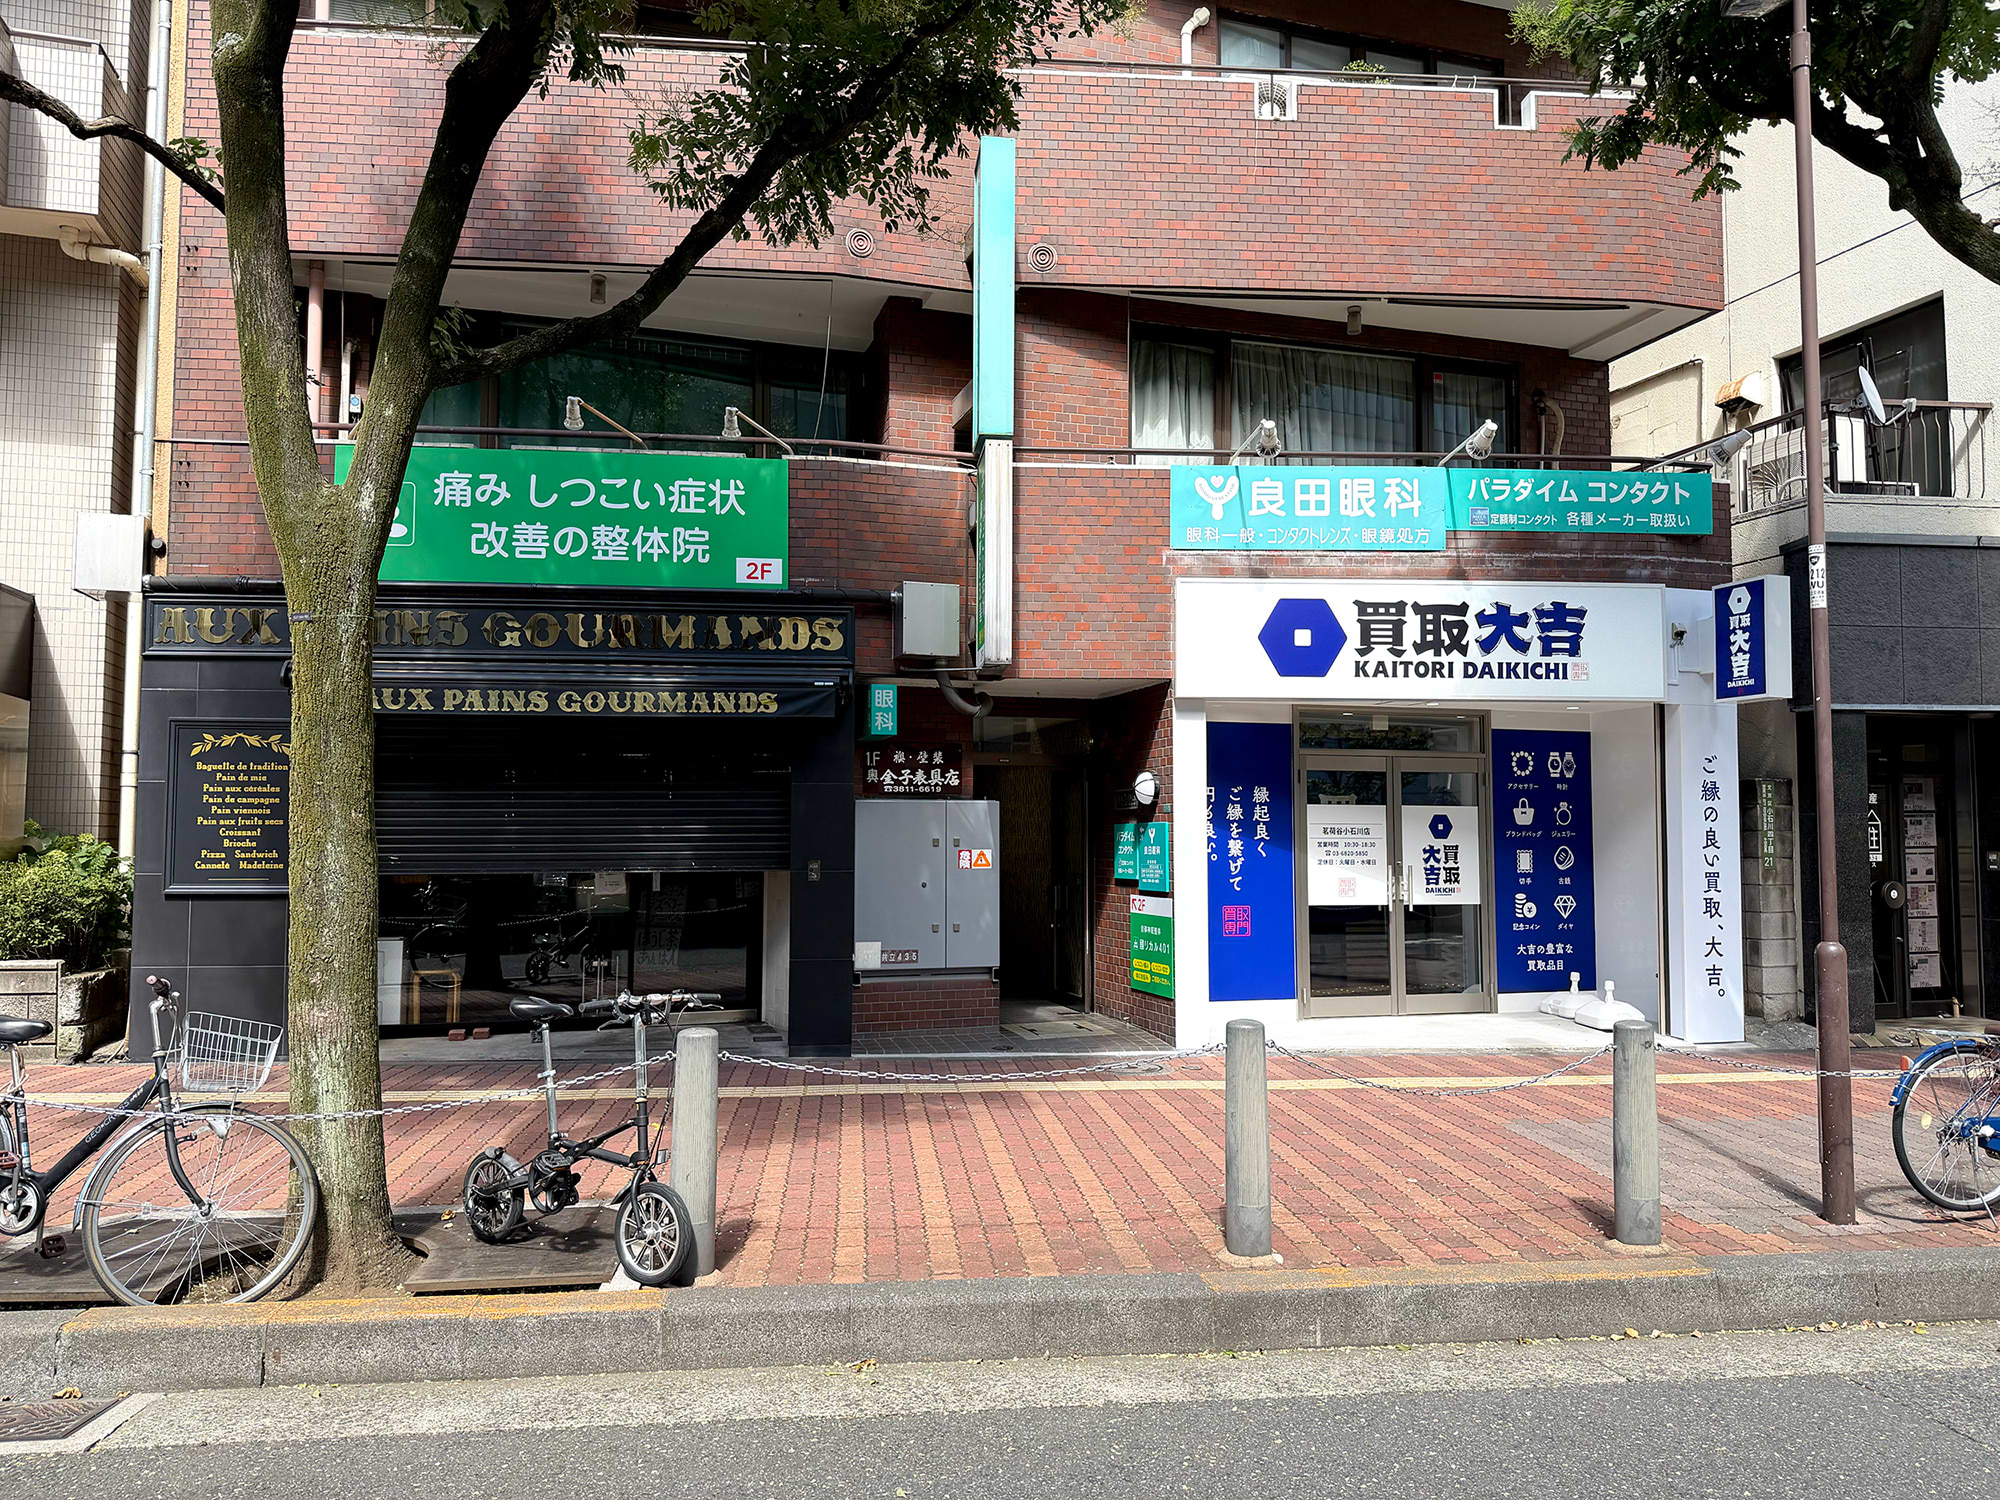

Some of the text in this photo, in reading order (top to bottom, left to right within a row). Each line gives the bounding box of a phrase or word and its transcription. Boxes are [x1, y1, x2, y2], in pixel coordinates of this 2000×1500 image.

[433, 469, 746, 516] 痛み しつこい症状
[1248, 477, 1422, 518] 良田眼科
[1466, 477, 1691, 506] パラダイム コンタクト
[1490, 511, 1691, 528] 定額制コンタクト 各種メーカー取扱い
[470, 520, 711, 564] 改善の整体院
[1186, 526, 1431, 545] 眼科一般・コンタクトレンズ・眼鏡処方
[745, 561, 774, 580] 2F
[154, 607, 845, 651] AUX INS GOURMANDS
[1352, 600, 1589, 658] 買取大吉
[1729, 629, 1751, 678] 大吉
[1354, 660, 1569, 680] KAITORI DAIKICHI
[1727, 678, 1755, 688] DAIKICHI
[442, 688, 550, 713] PAINS
[557, 690, 779, 714] GOURMANDS
[875, 689, 893, 731] 眼科
[196, 761, 288, 772] Baguette de tradition
[216, 772, 267, 781] Pain de mie
[866, 768, 880, 784] 奥
[880, 768, 960, 786] 金子表具店
[203, 783, 223, 792] Pain
[243, 783, 280, 793] céréales
[202, 794, 280, 805] Pain de campagne
[211, 805, 271, 814] Pain viennois
[196, 816, 217, 825] Pain
[237, 816, 263, 826] fruits
[1253, 786, 1270, 858] 縁起良く
[219, 827, 261, 837] Croissant
[1322, 826, 1371, 836] 茗荷谷小石川店
[1505, 830, 1542, 838] ブランドバッグ
[1551, 830, 1576, 838] ジュエリー
[223, 838, 256, 847] Brioche
[1226, 786, 1245, 892] ご縁を繋げて
[201, 849, 278, 858] Pizza Sandwich
[194, 860, 284, 870] Cannelé Madeleine
[1422, 844, 1441, 886] 大吉
[1443, 844, 1460, 885] 買取
[1764, 857, 1773, 867] 21
[1518, 877, 1532, 885] 切手
[1700, 754, 1726, 998] ご縁の良い買取、大吉。
[1138, 898, 1146, 911] 2F
[1512, 922, 1541, 931] 記念コイン
[1557, 922, 1574, 930] ダイヤ
[1516, 943, 1574, 955] 大吉の豊富な
[1527, 960, 1564, 971] 買取品目
